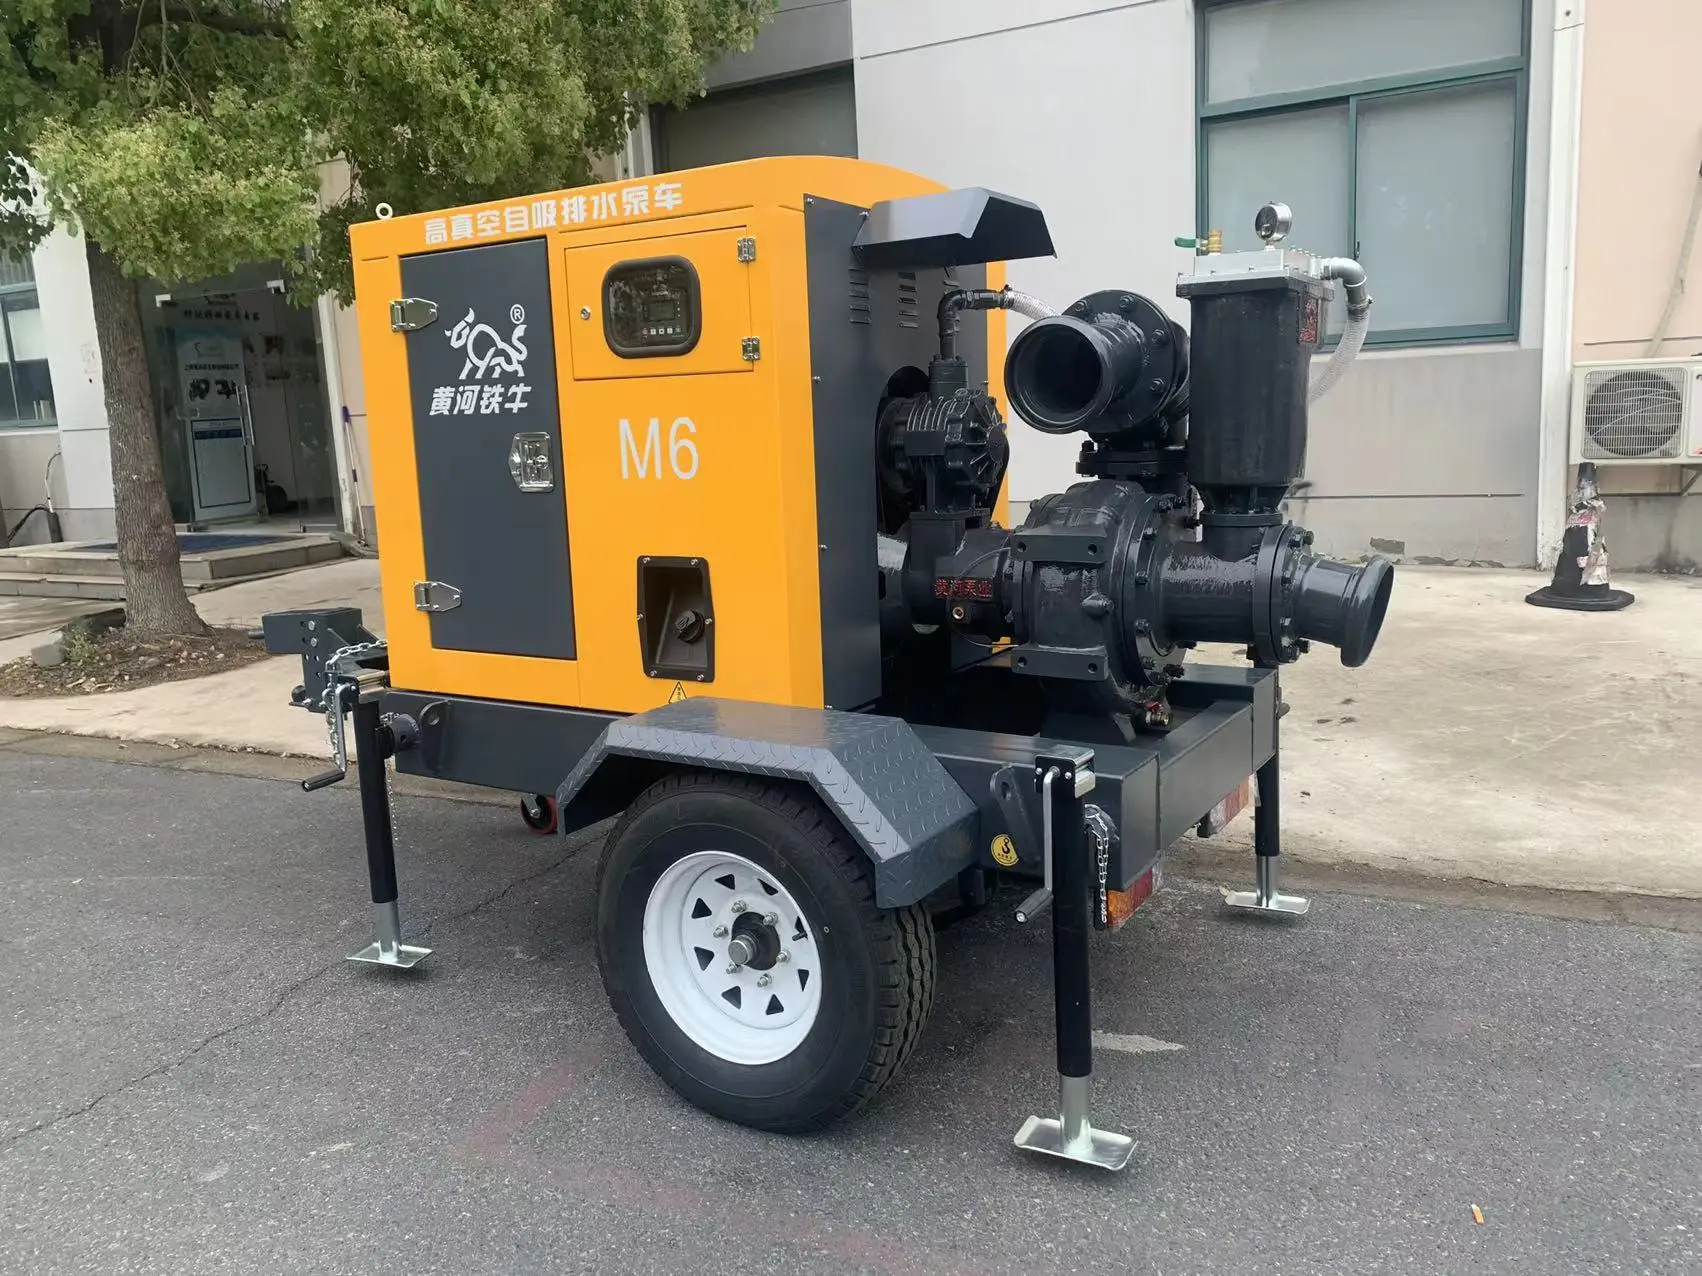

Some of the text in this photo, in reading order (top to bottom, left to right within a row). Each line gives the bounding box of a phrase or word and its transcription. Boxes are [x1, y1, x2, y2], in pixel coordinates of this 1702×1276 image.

[424, 183, 683, 244] 高真空自吸排水泵车
[429, 383, 531, 415] 黄河铁牛
[618, 416, 699, 480] M6
